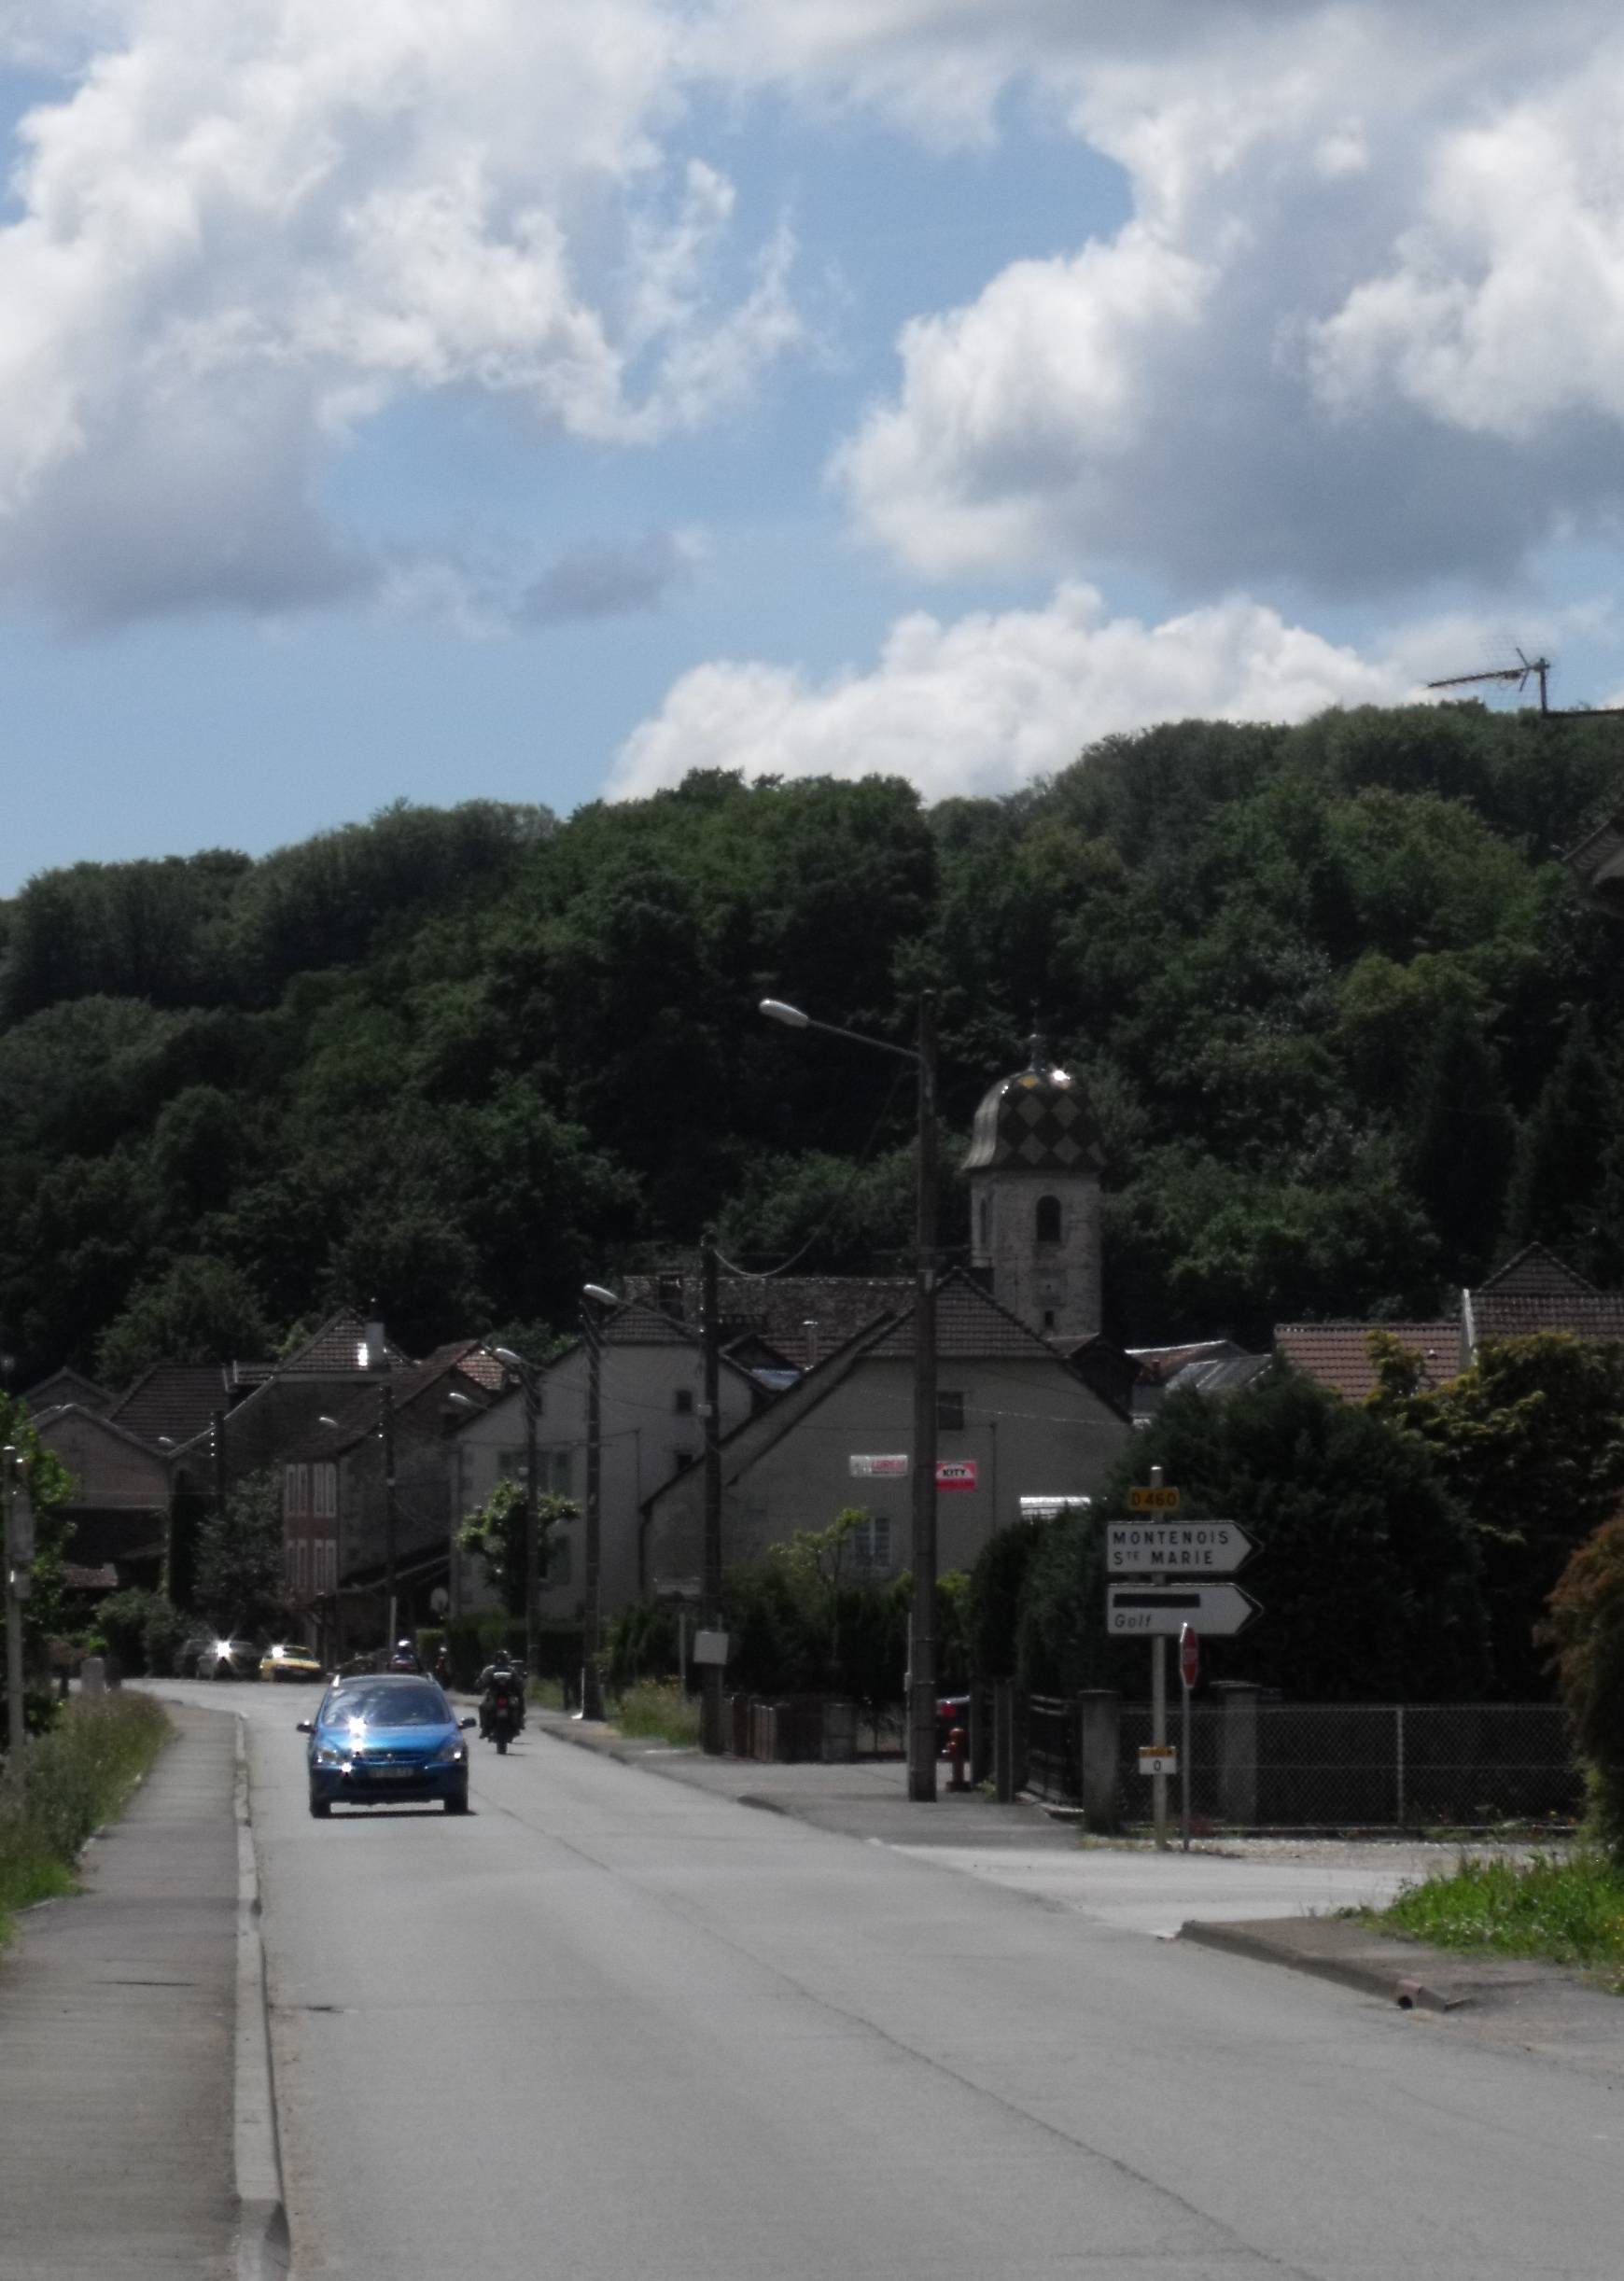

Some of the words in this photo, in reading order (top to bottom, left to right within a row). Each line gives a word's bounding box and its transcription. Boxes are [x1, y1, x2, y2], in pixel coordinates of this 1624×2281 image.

[1131, 1492, 1141, 1506] D
[1144, 1492, 1177, 1507] 460
[1113, 1531, 1229, 1546] MONTENOIS
[1150, 1550, 1213, 1565] MARIE
[1114, 1614, 1153, 1628] Golf
